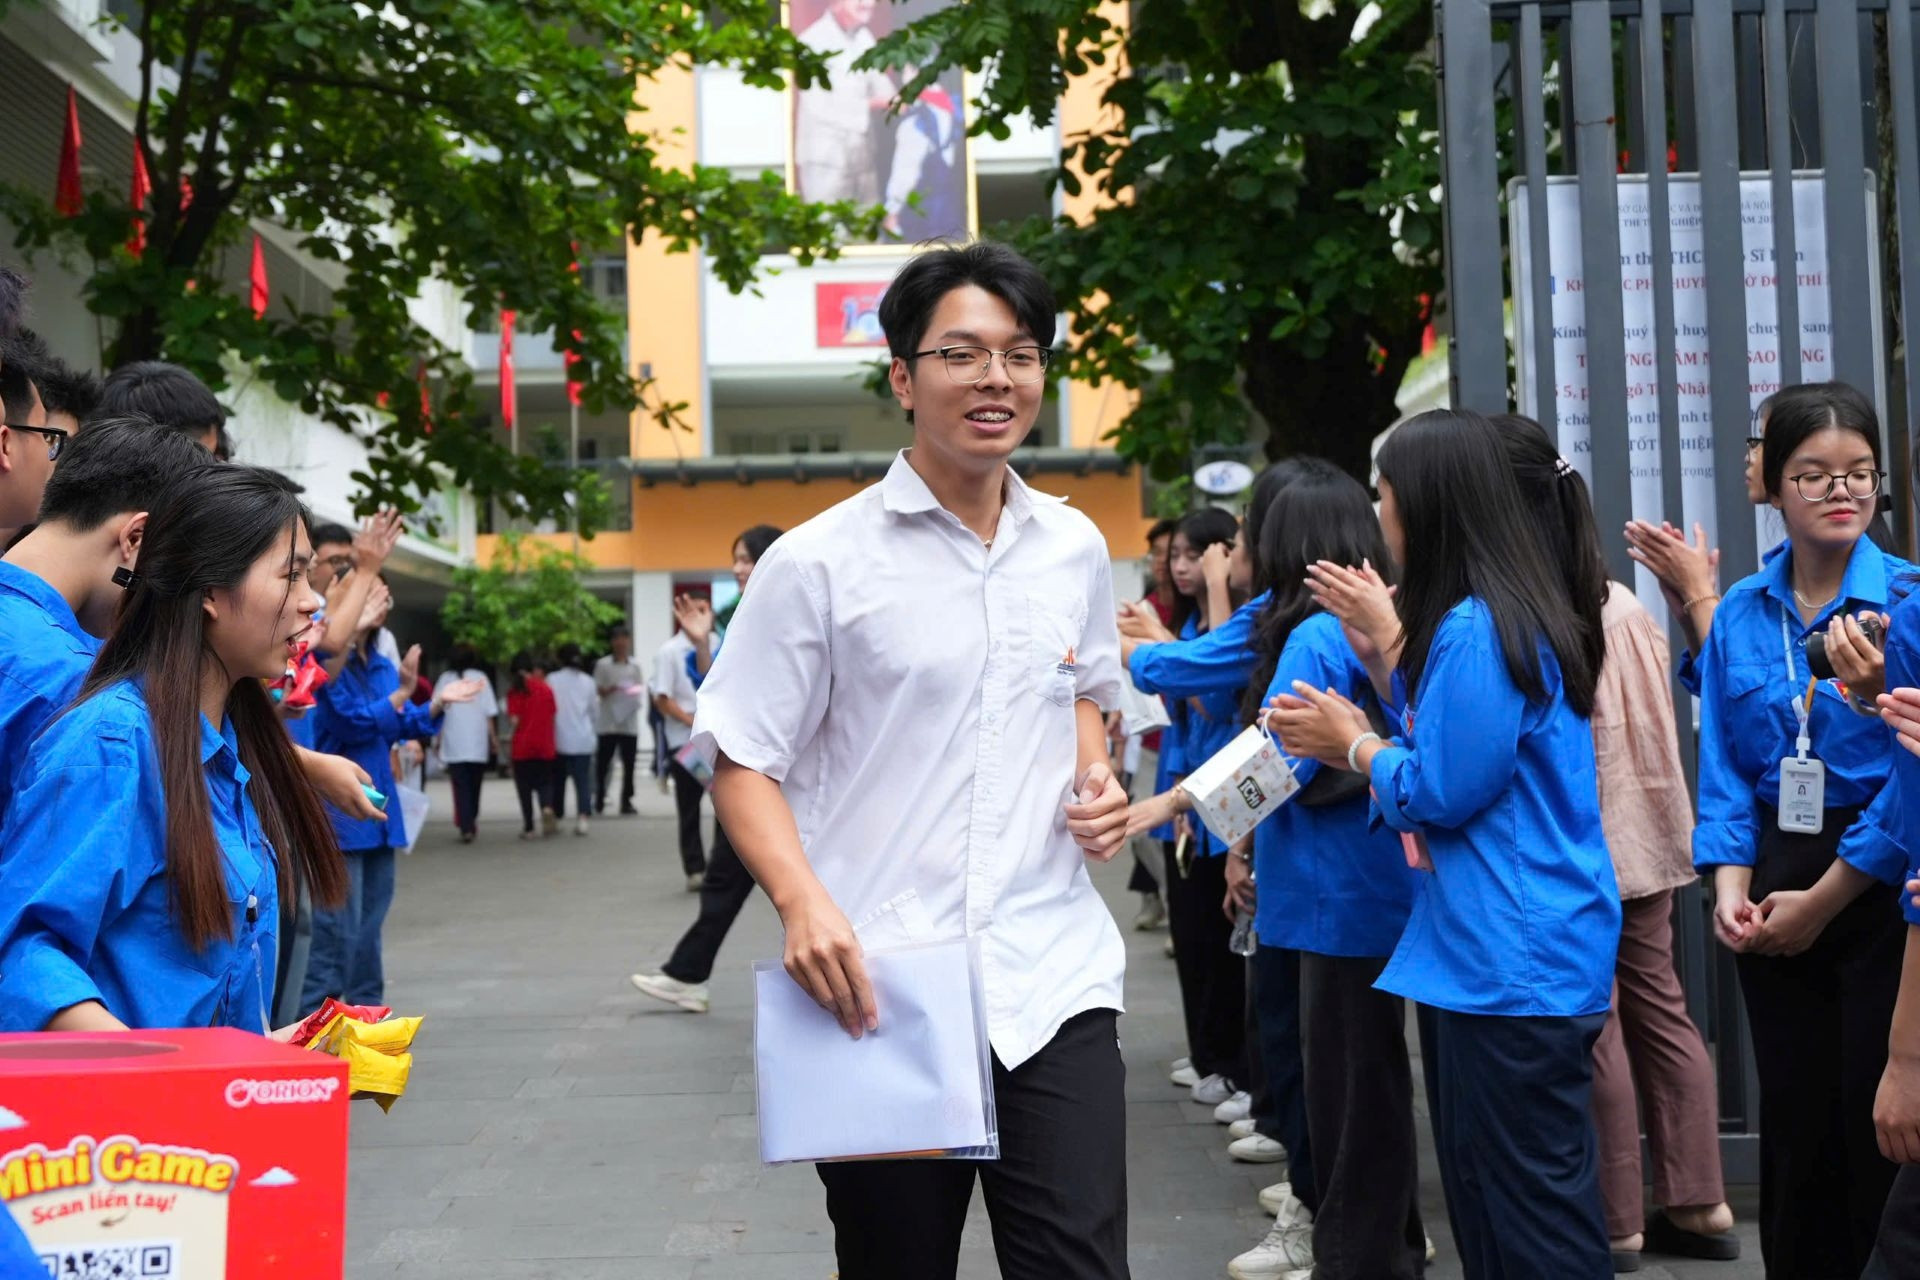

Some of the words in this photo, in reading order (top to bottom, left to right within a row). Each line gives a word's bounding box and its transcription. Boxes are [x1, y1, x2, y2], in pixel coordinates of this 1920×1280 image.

[1671, 250, 1703, 265] THC
[1682, 323, 1708, 338] huy
[253, 1079, 332, 1104] ORION
[0, 1140, 94, 1201] Mini
[100, 1140, 235, 1193] Game
[32, 1199, 84, 1225] Scan
[135, 1193, 177, 1213] tay!
